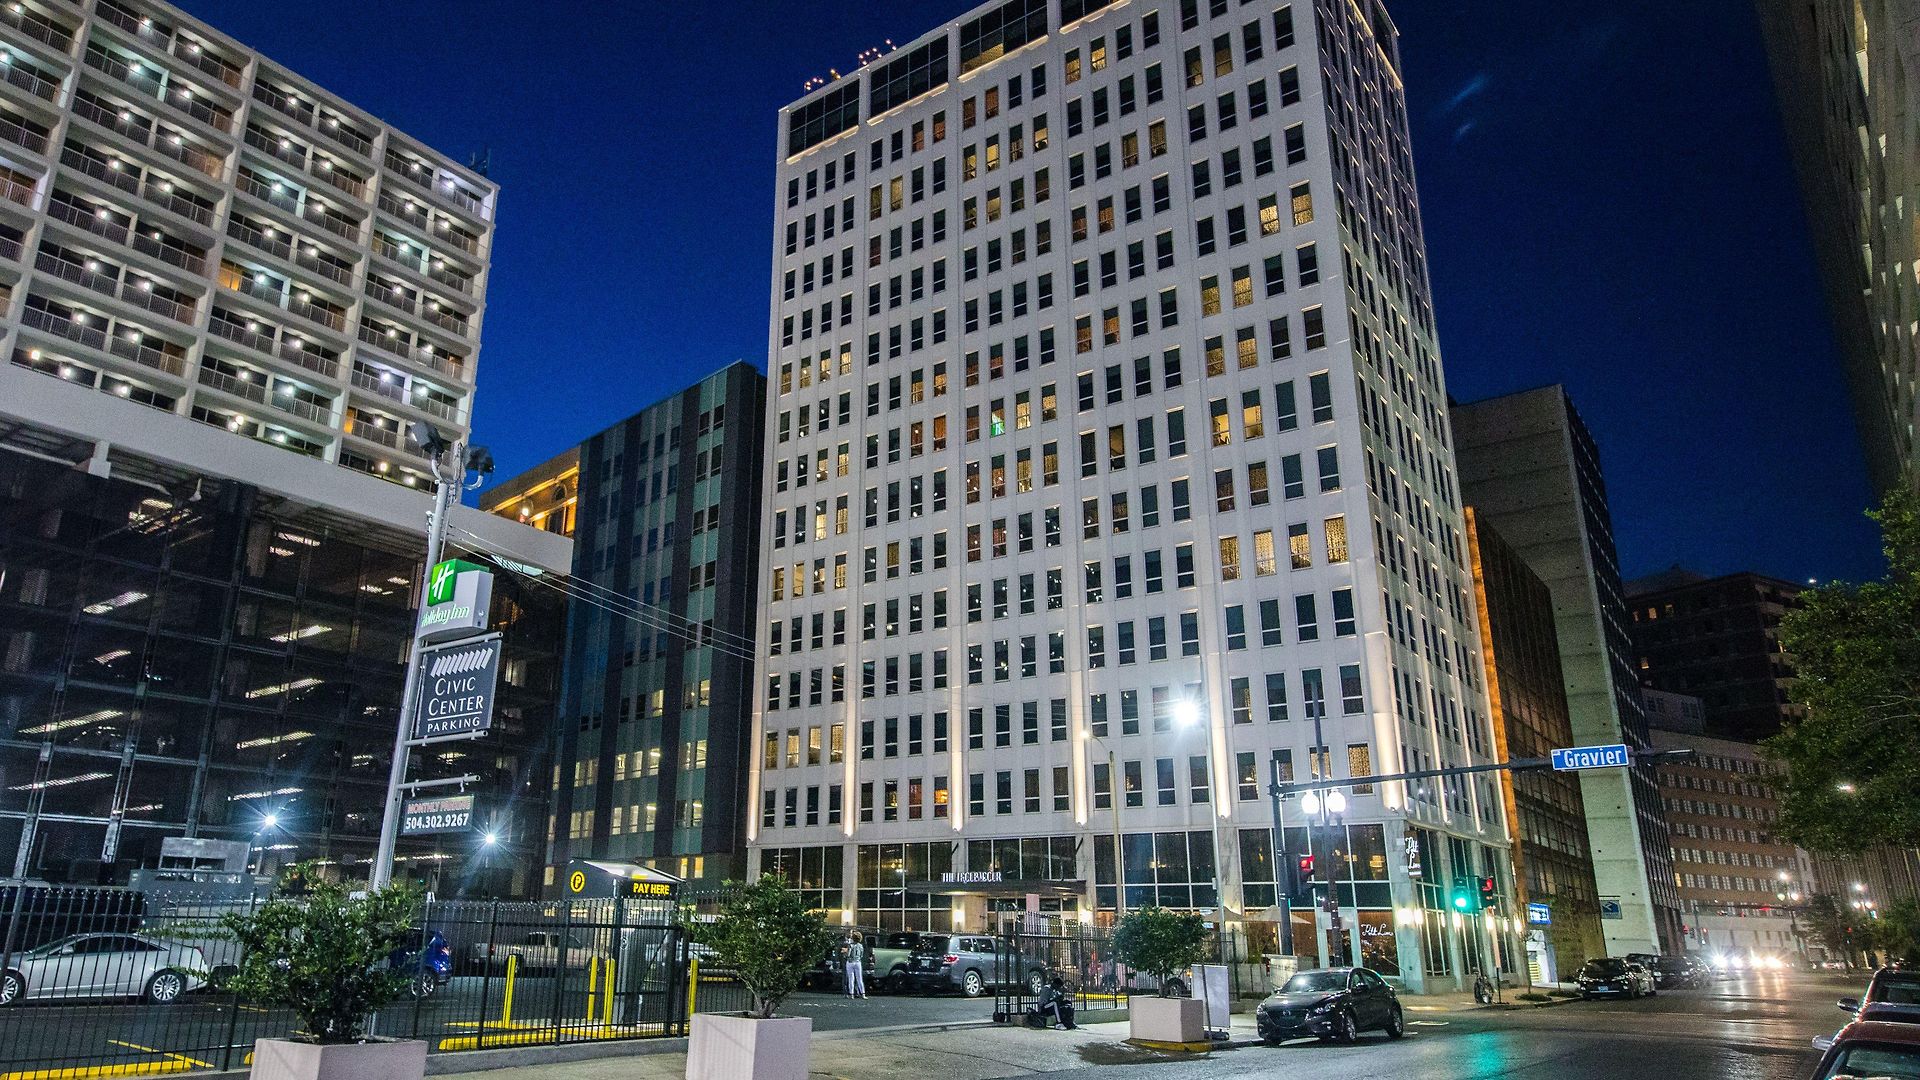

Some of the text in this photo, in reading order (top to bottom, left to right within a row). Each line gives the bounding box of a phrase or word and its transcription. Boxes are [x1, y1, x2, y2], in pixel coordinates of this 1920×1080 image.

[450, 603, 470, 620] Inn
[435, 676, 476, 696] CIVIC
[428, 695, 484, 716] CENTER
[427, 716, 480, 733] PARKING
[1563, 747, 1622, 768] Gravier
[405, 812, 470, 830] 504.302.9267
[633, 882, 670, 895] PAY HERE
